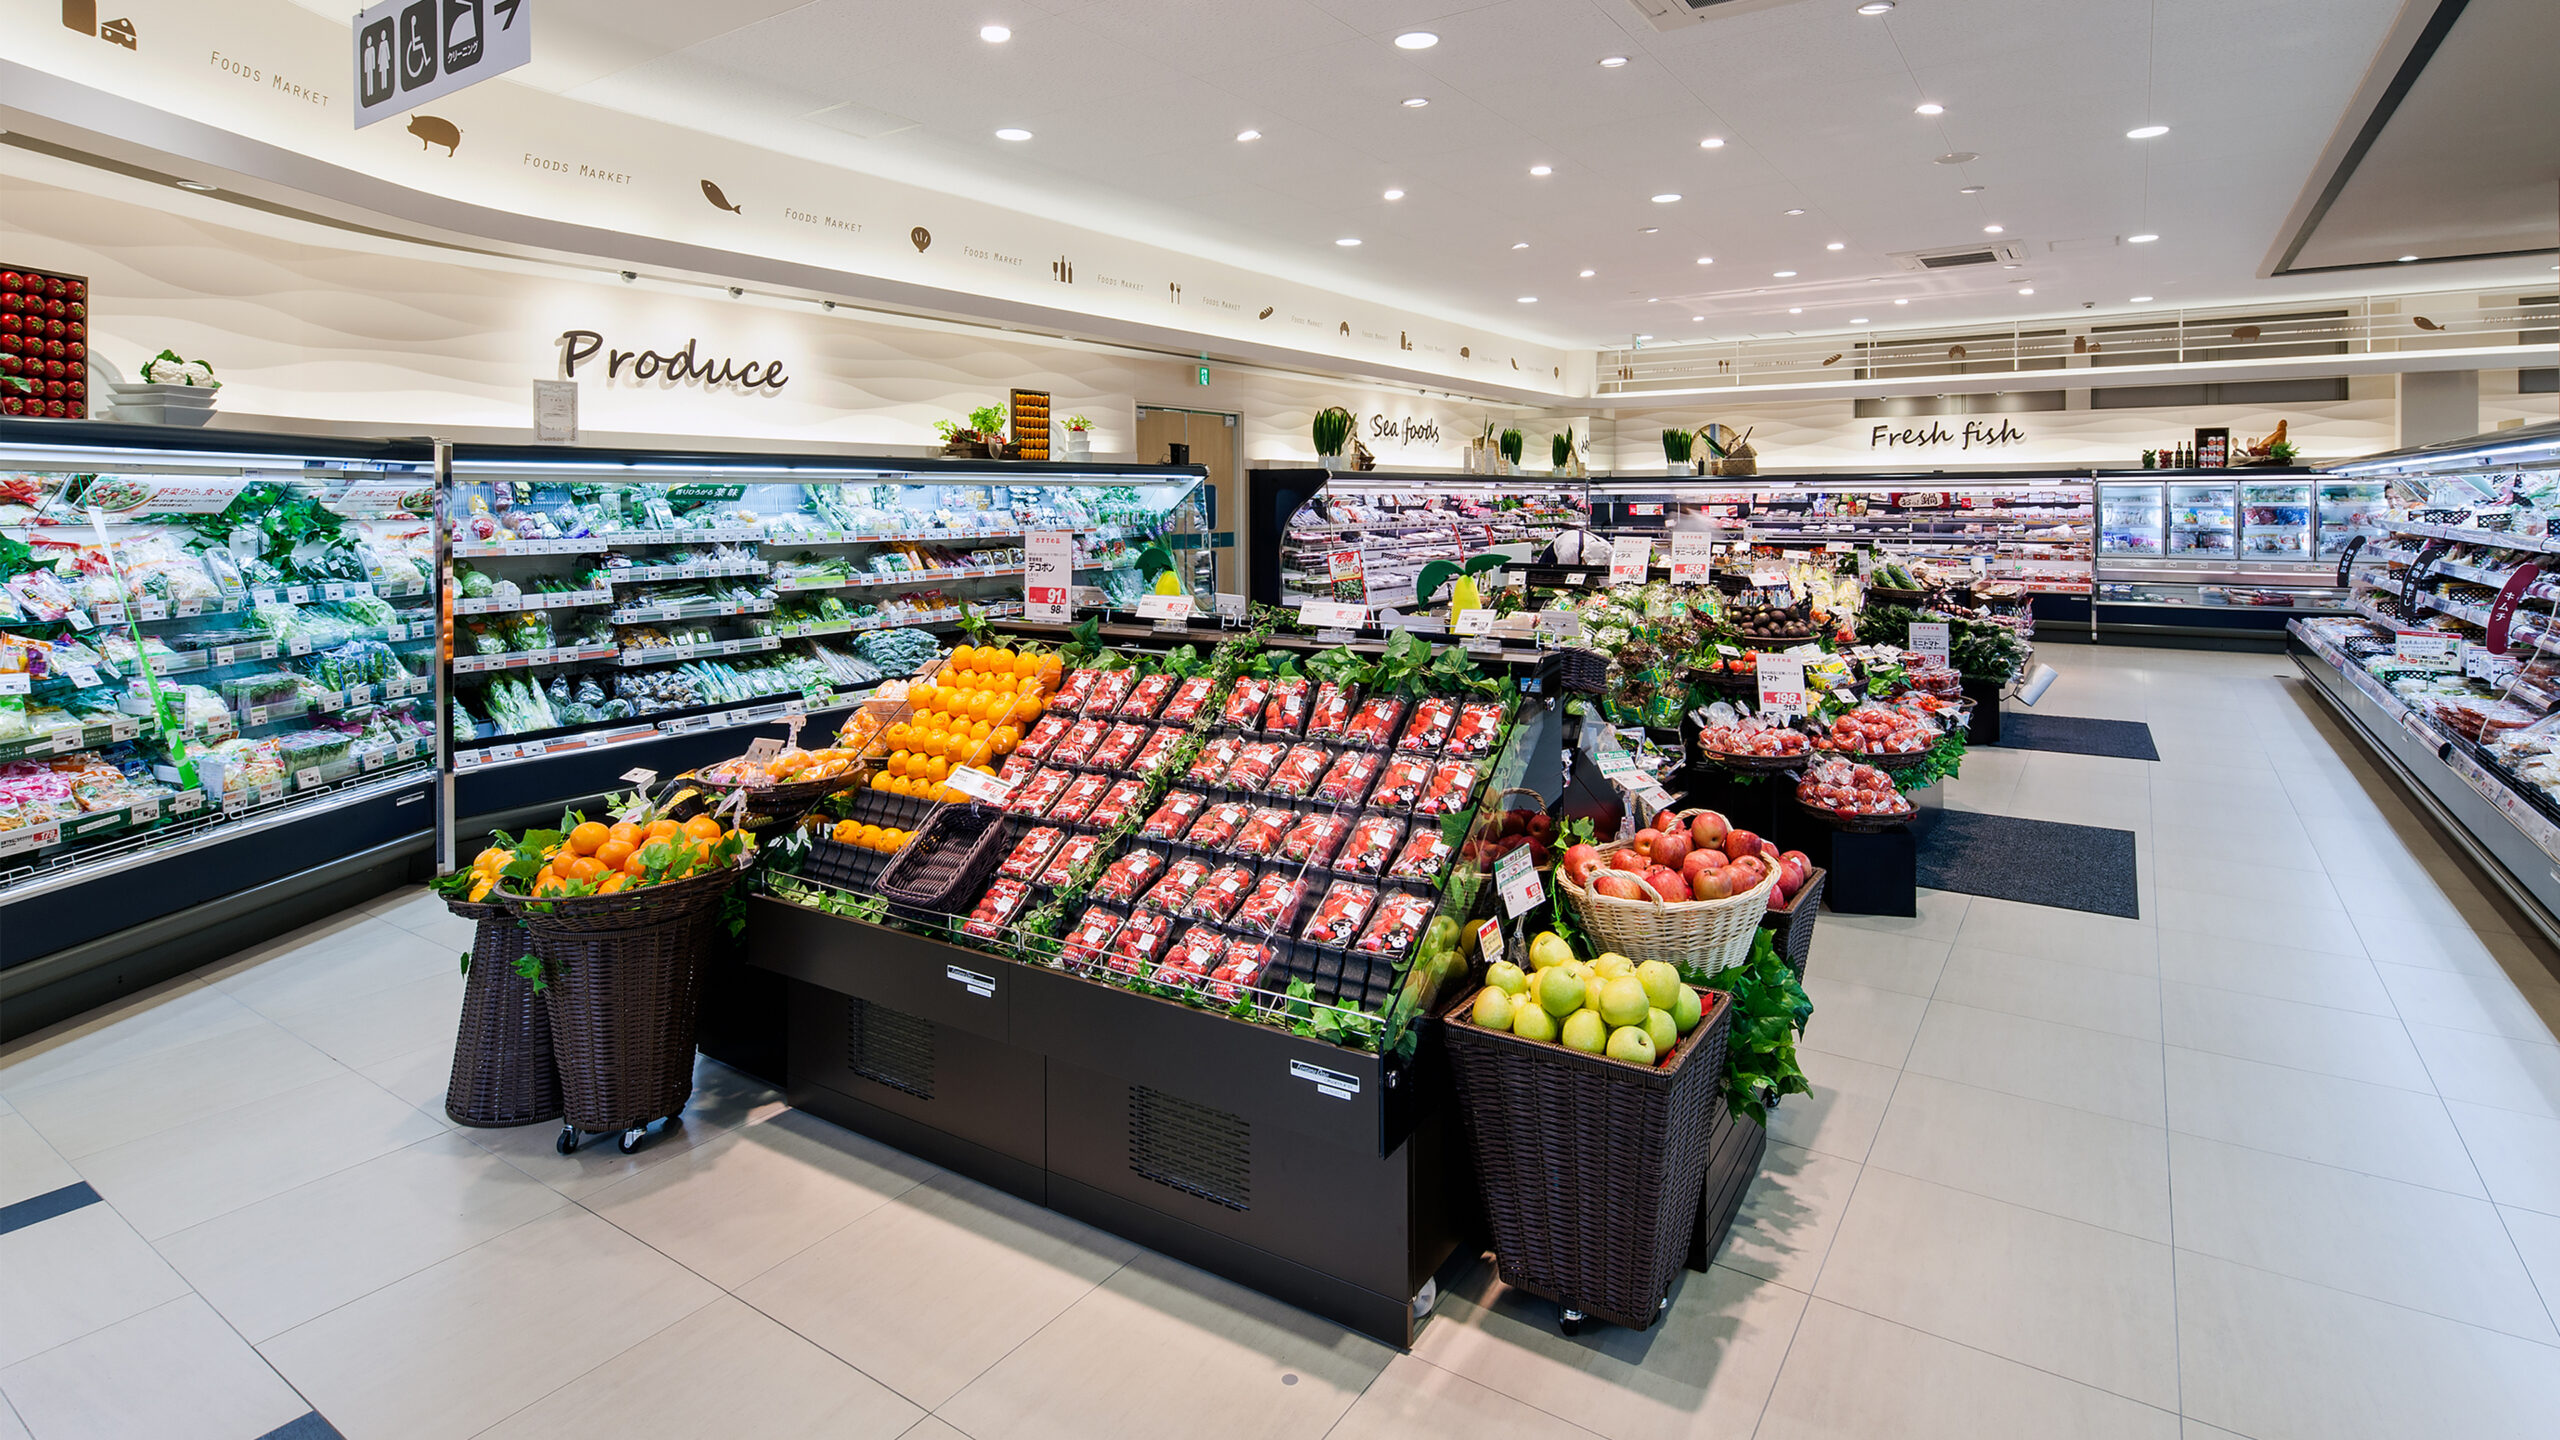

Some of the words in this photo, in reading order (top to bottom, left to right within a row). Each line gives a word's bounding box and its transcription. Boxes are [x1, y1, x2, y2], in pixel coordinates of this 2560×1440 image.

[446, 40, 479, 64] クリーニング
[563, 329, 789, 388] Produce
[1373, 413, 1399, 438] Sea
[1403, 416, 1440, 446] foods
[1871, 420, 1954, 447] Fresh
[1961, 418, 2025, 451] fish
[1050, 604, 1062, 614] 98
[2495, 591, 2516, 622] キムチ
[1761, 674, 1780, 682] トマト
[1774, 693, 1797, 704] 198
